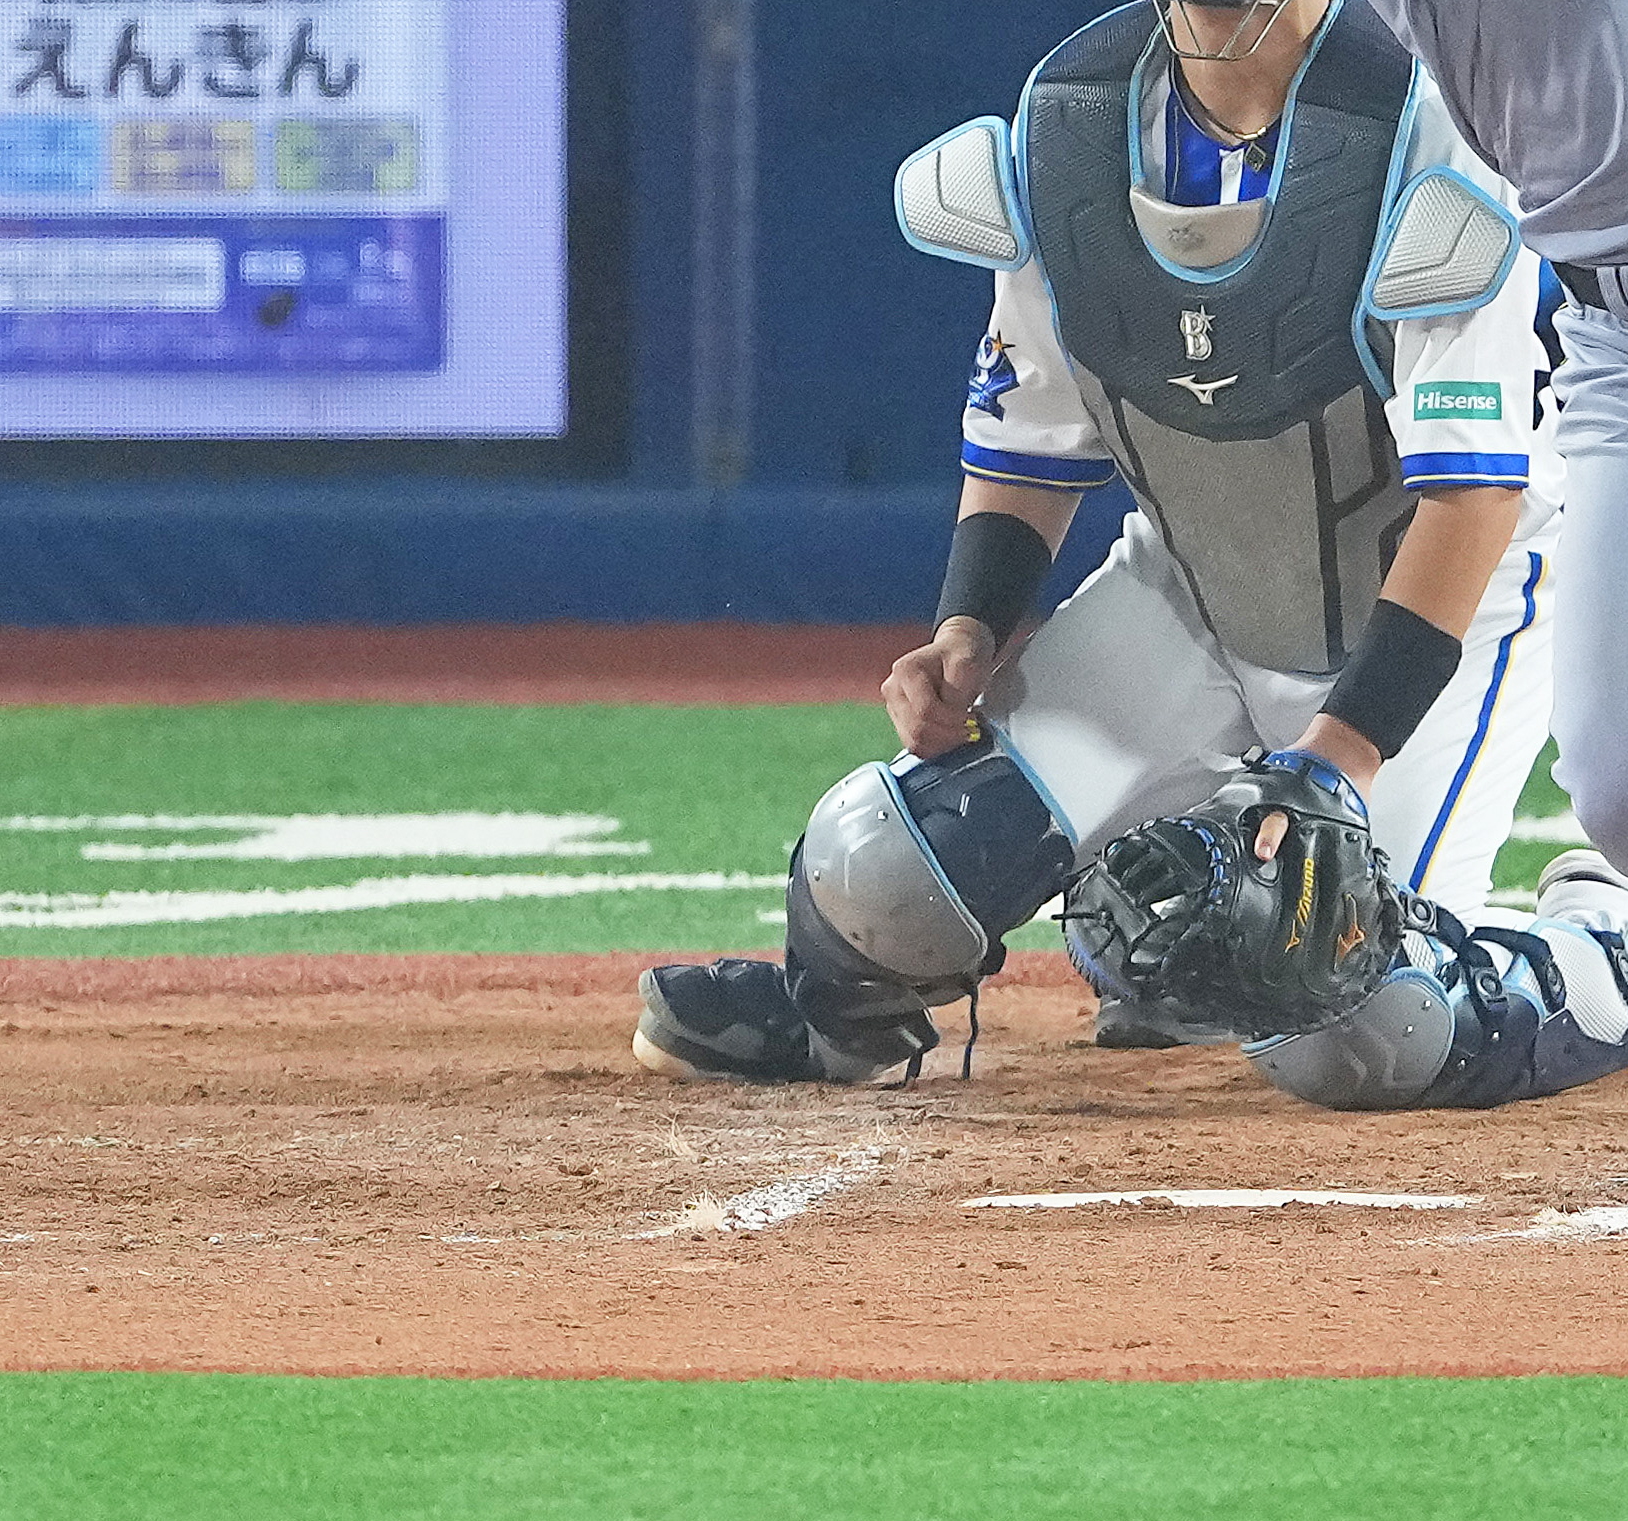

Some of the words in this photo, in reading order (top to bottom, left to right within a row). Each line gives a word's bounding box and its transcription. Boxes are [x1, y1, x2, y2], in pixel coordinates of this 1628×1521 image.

[8, 17, 361, 100] えんきん
[1417, 390, 1498, 411] Hisense
